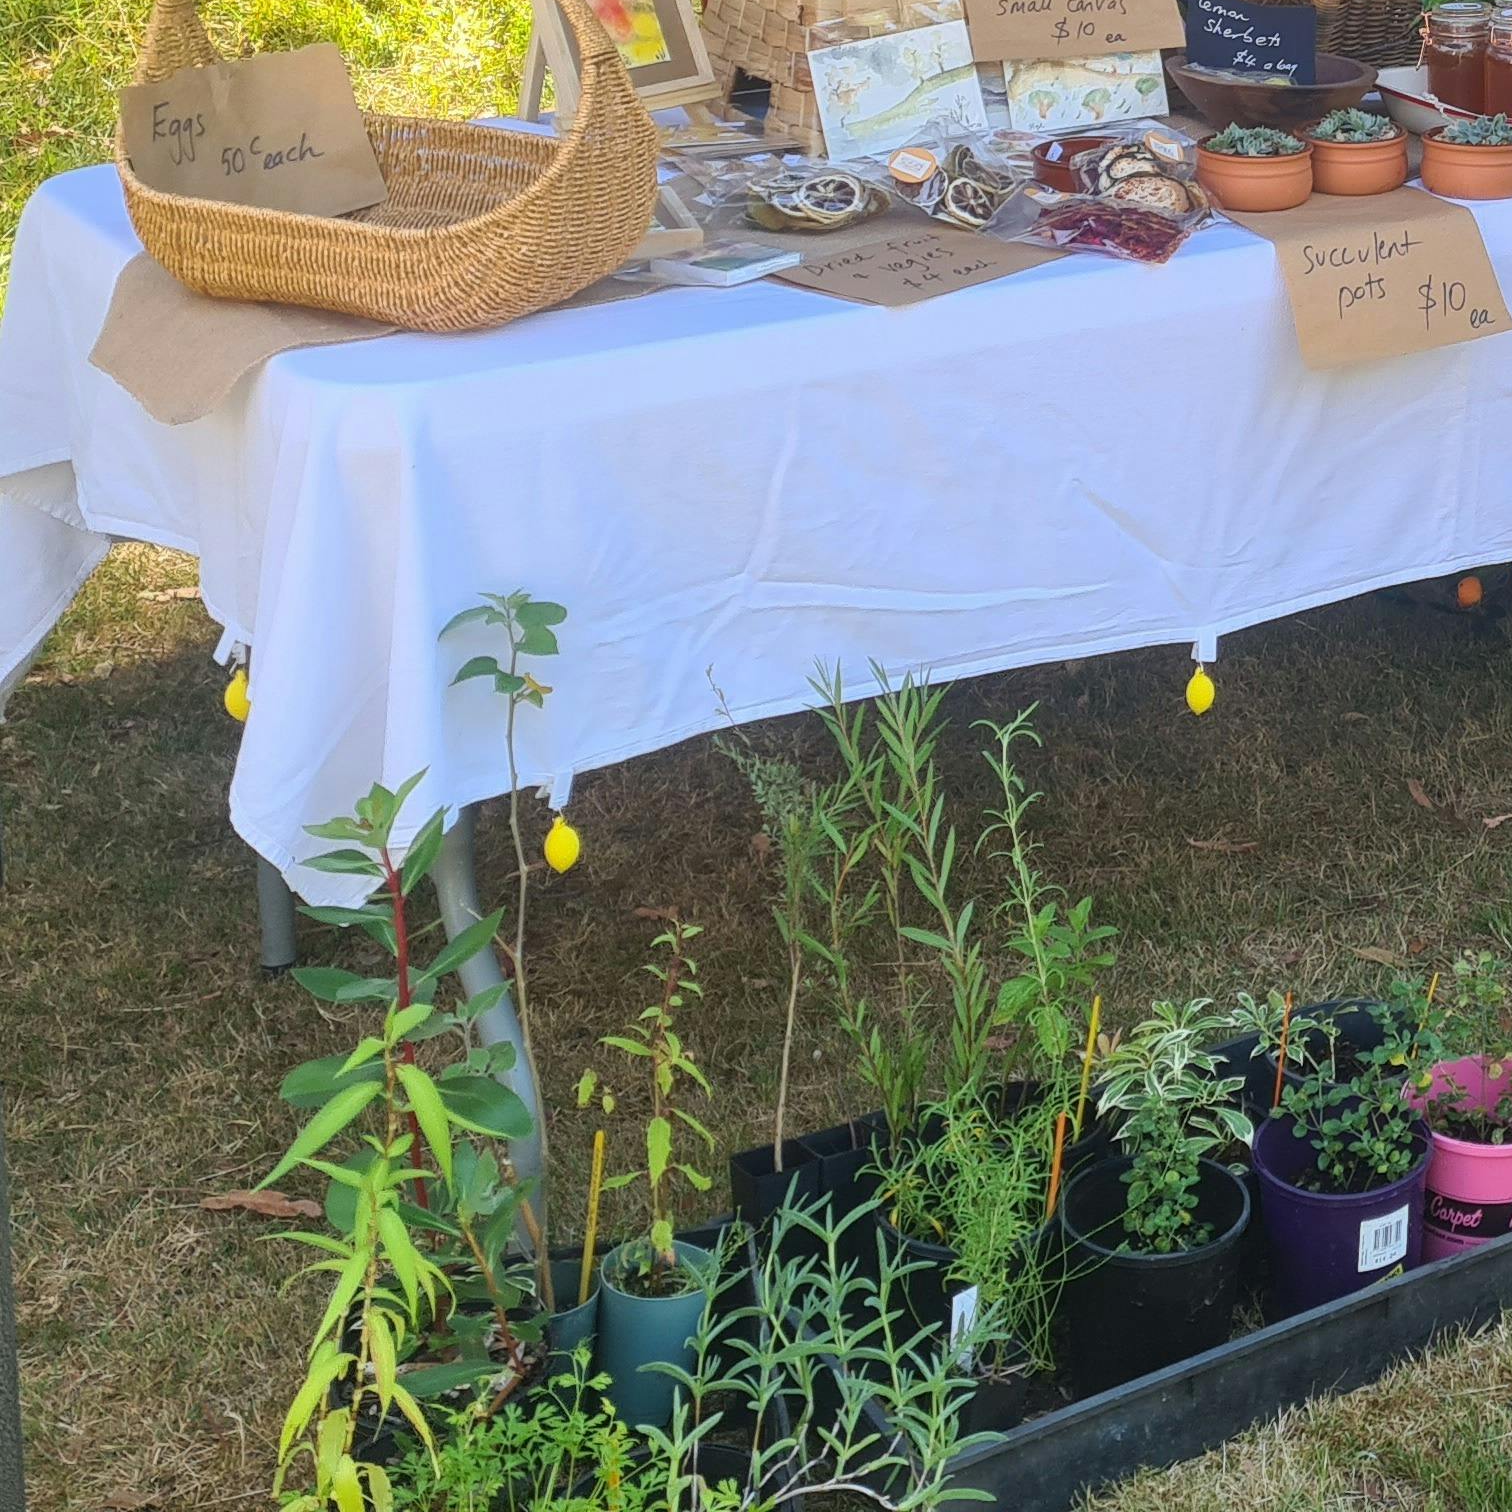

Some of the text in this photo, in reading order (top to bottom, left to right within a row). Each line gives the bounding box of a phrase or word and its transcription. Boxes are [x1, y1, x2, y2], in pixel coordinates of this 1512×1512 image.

[1050, 17, 1127, 46] $10 ea
[1276, 59, 1298, 74] bag
[152, 101, 205, 166] Eggs
[263, 132, 325, 171] each
[802, 253, 874, 277] Dried
[1303, 230, 1423, 275] Succulent
[1338, 272, 1496, 331] pots $10 ea
[1430, 1195, 1483, 1233] Carpet
